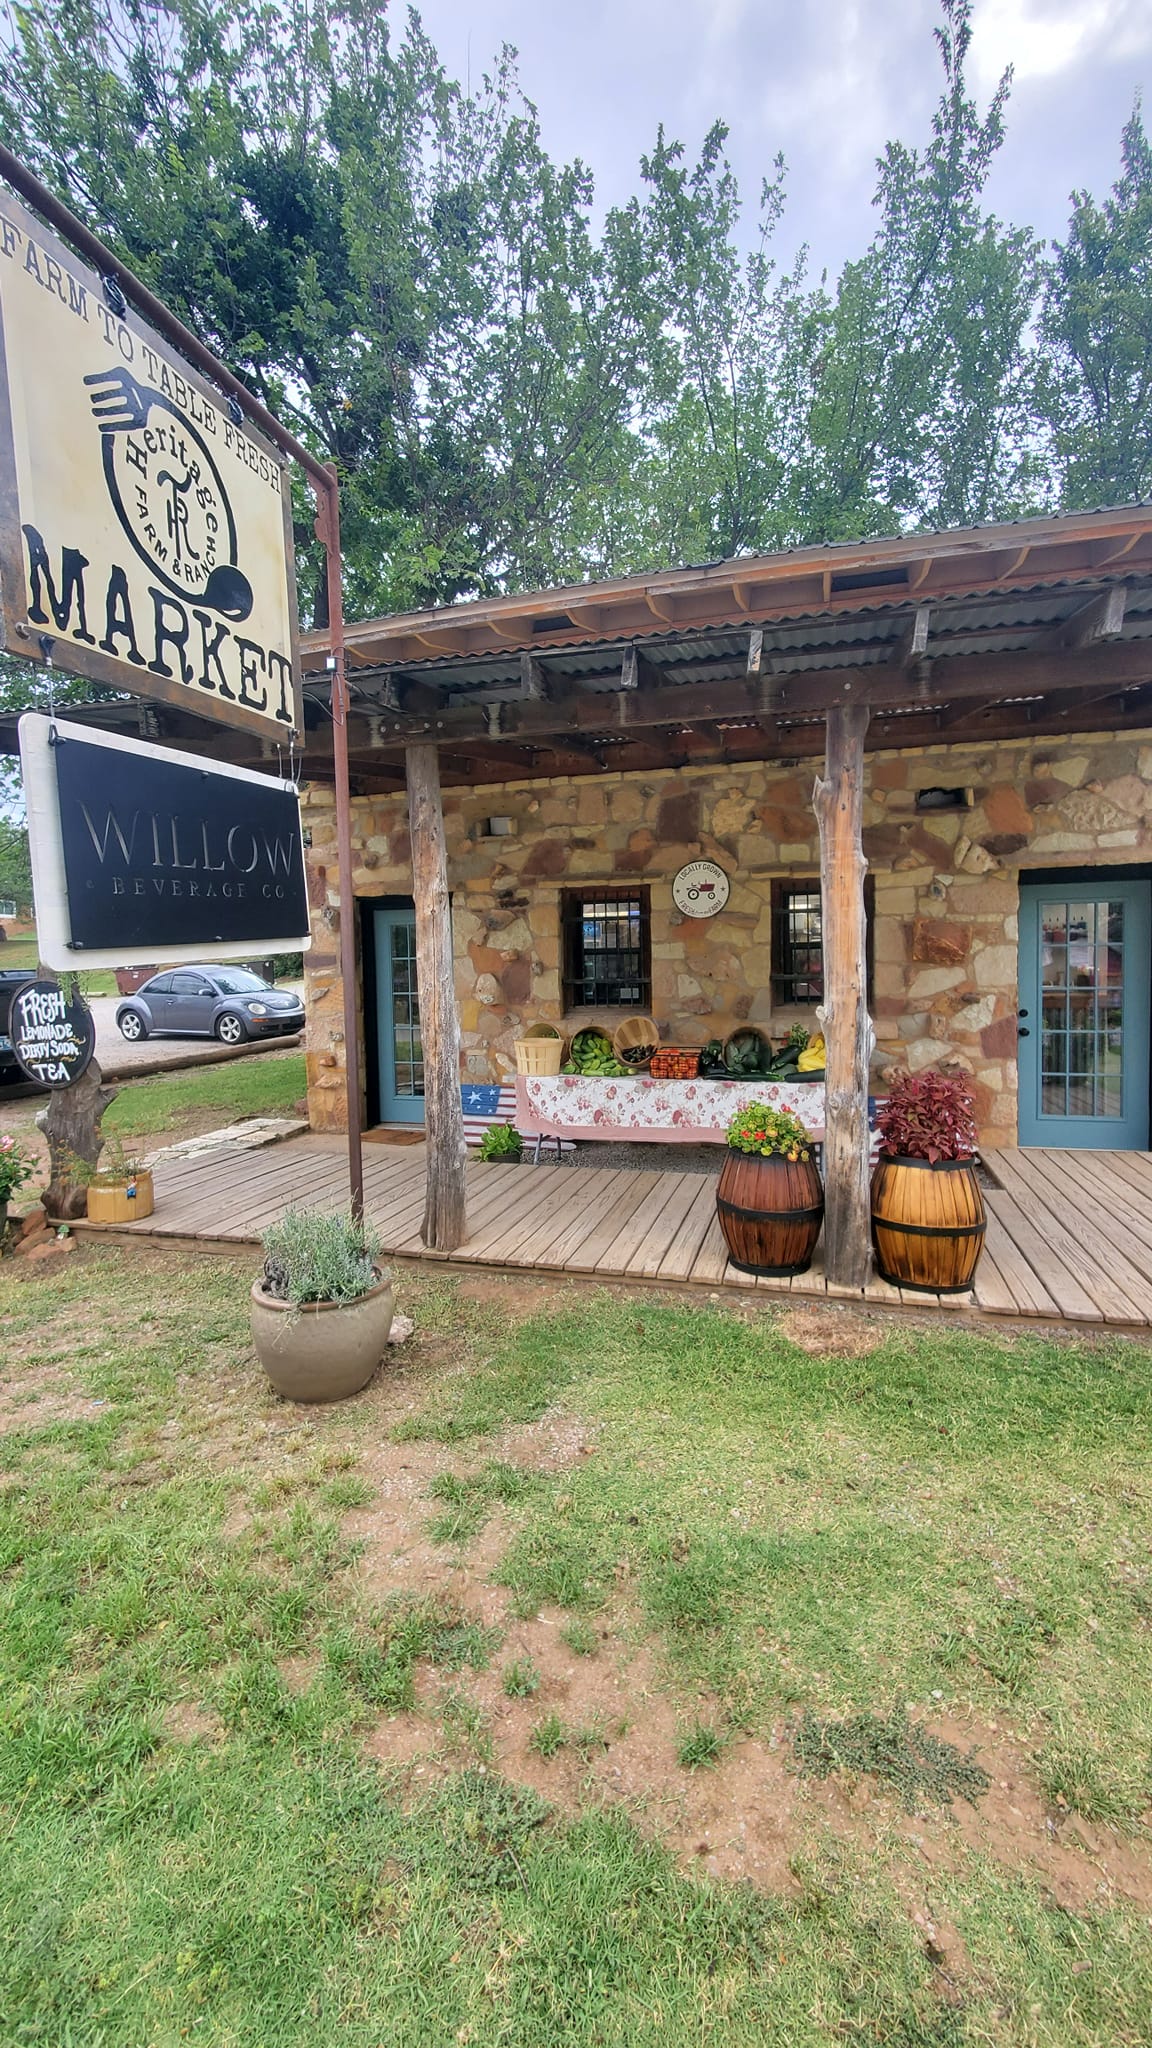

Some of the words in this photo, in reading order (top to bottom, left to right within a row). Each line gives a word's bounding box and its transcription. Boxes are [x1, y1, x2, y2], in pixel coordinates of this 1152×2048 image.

[0, 216, 90, 324] FARM
[98, 303, 134, 364] TO
[142, 344, 217, 436] TABLE
[223, 418, 281, 495] FRESH
[126, 424, 218, 534] Heritage
[135, 484, 168, 562] FARM
[173, 558, 182, 577] &
[184, 535, 217, 584] RANCH
[21, 523, 294, 724] MARKET
[78, 799, 295, 877] WILLOW
[112, 875, 247, 899] BEVERAGE
[678, 863, 702, 881] LOCALLY
[702, 863, 722, 879] GROWN
[18, 988, 66, 1027] FRESH
[19, 1042, 50, 1061] DIRTY
[20, 1022, 74, 1042] LEMONADE
[32, 1061, 71, 1082] TEA
